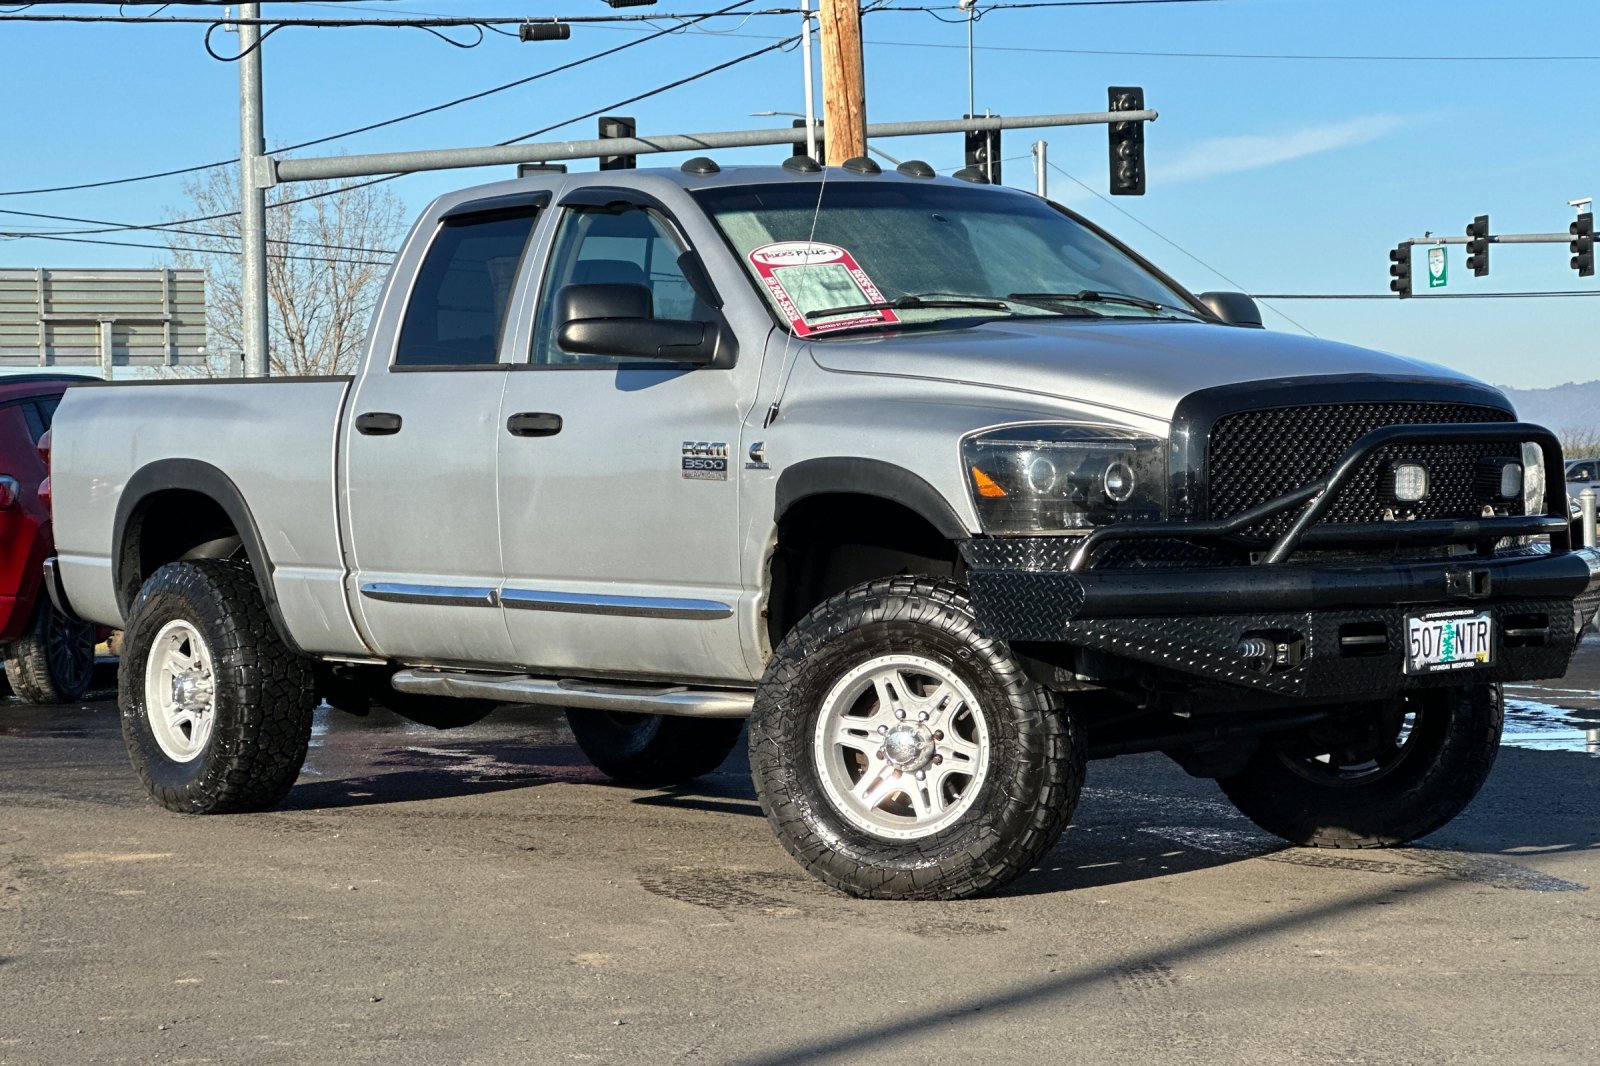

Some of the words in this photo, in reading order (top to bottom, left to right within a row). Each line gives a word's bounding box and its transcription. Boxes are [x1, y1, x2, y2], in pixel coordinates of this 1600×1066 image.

[685, 458, 724, 470] 3500
[1411, 625, 1443, 659] 507
[1456, 621, 1487, 655] NTR
[1452, 661, 1475, 669] MEDFORD
